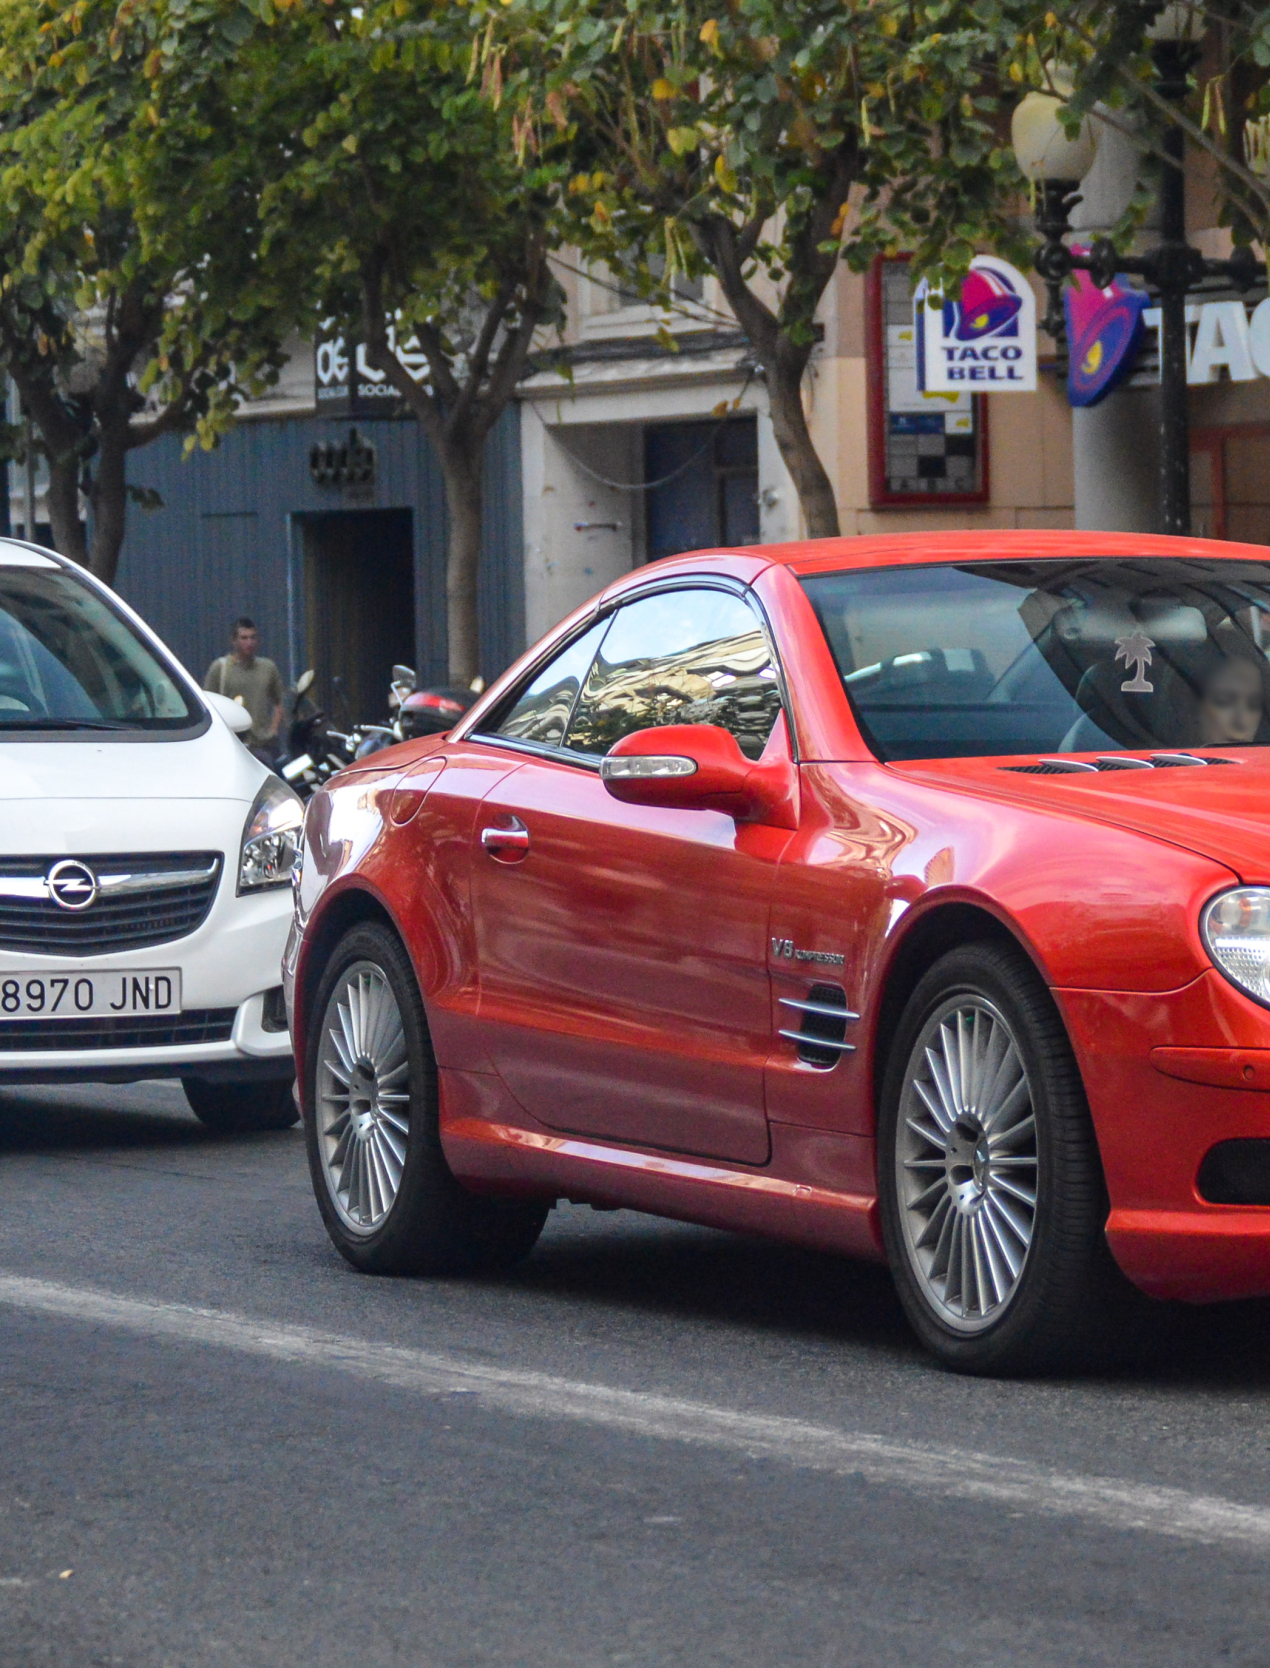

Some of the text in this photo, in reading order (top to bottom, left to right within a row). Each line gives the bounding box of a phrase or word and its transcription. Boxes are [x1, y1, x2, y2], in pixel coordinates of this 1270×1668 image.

[941, 345, 1023, 362] TACO
[946, 365, 1024, 381] BELL
[771, 937, 794, 958] V8
[1, 976, 172, 1013] 8970 JND
